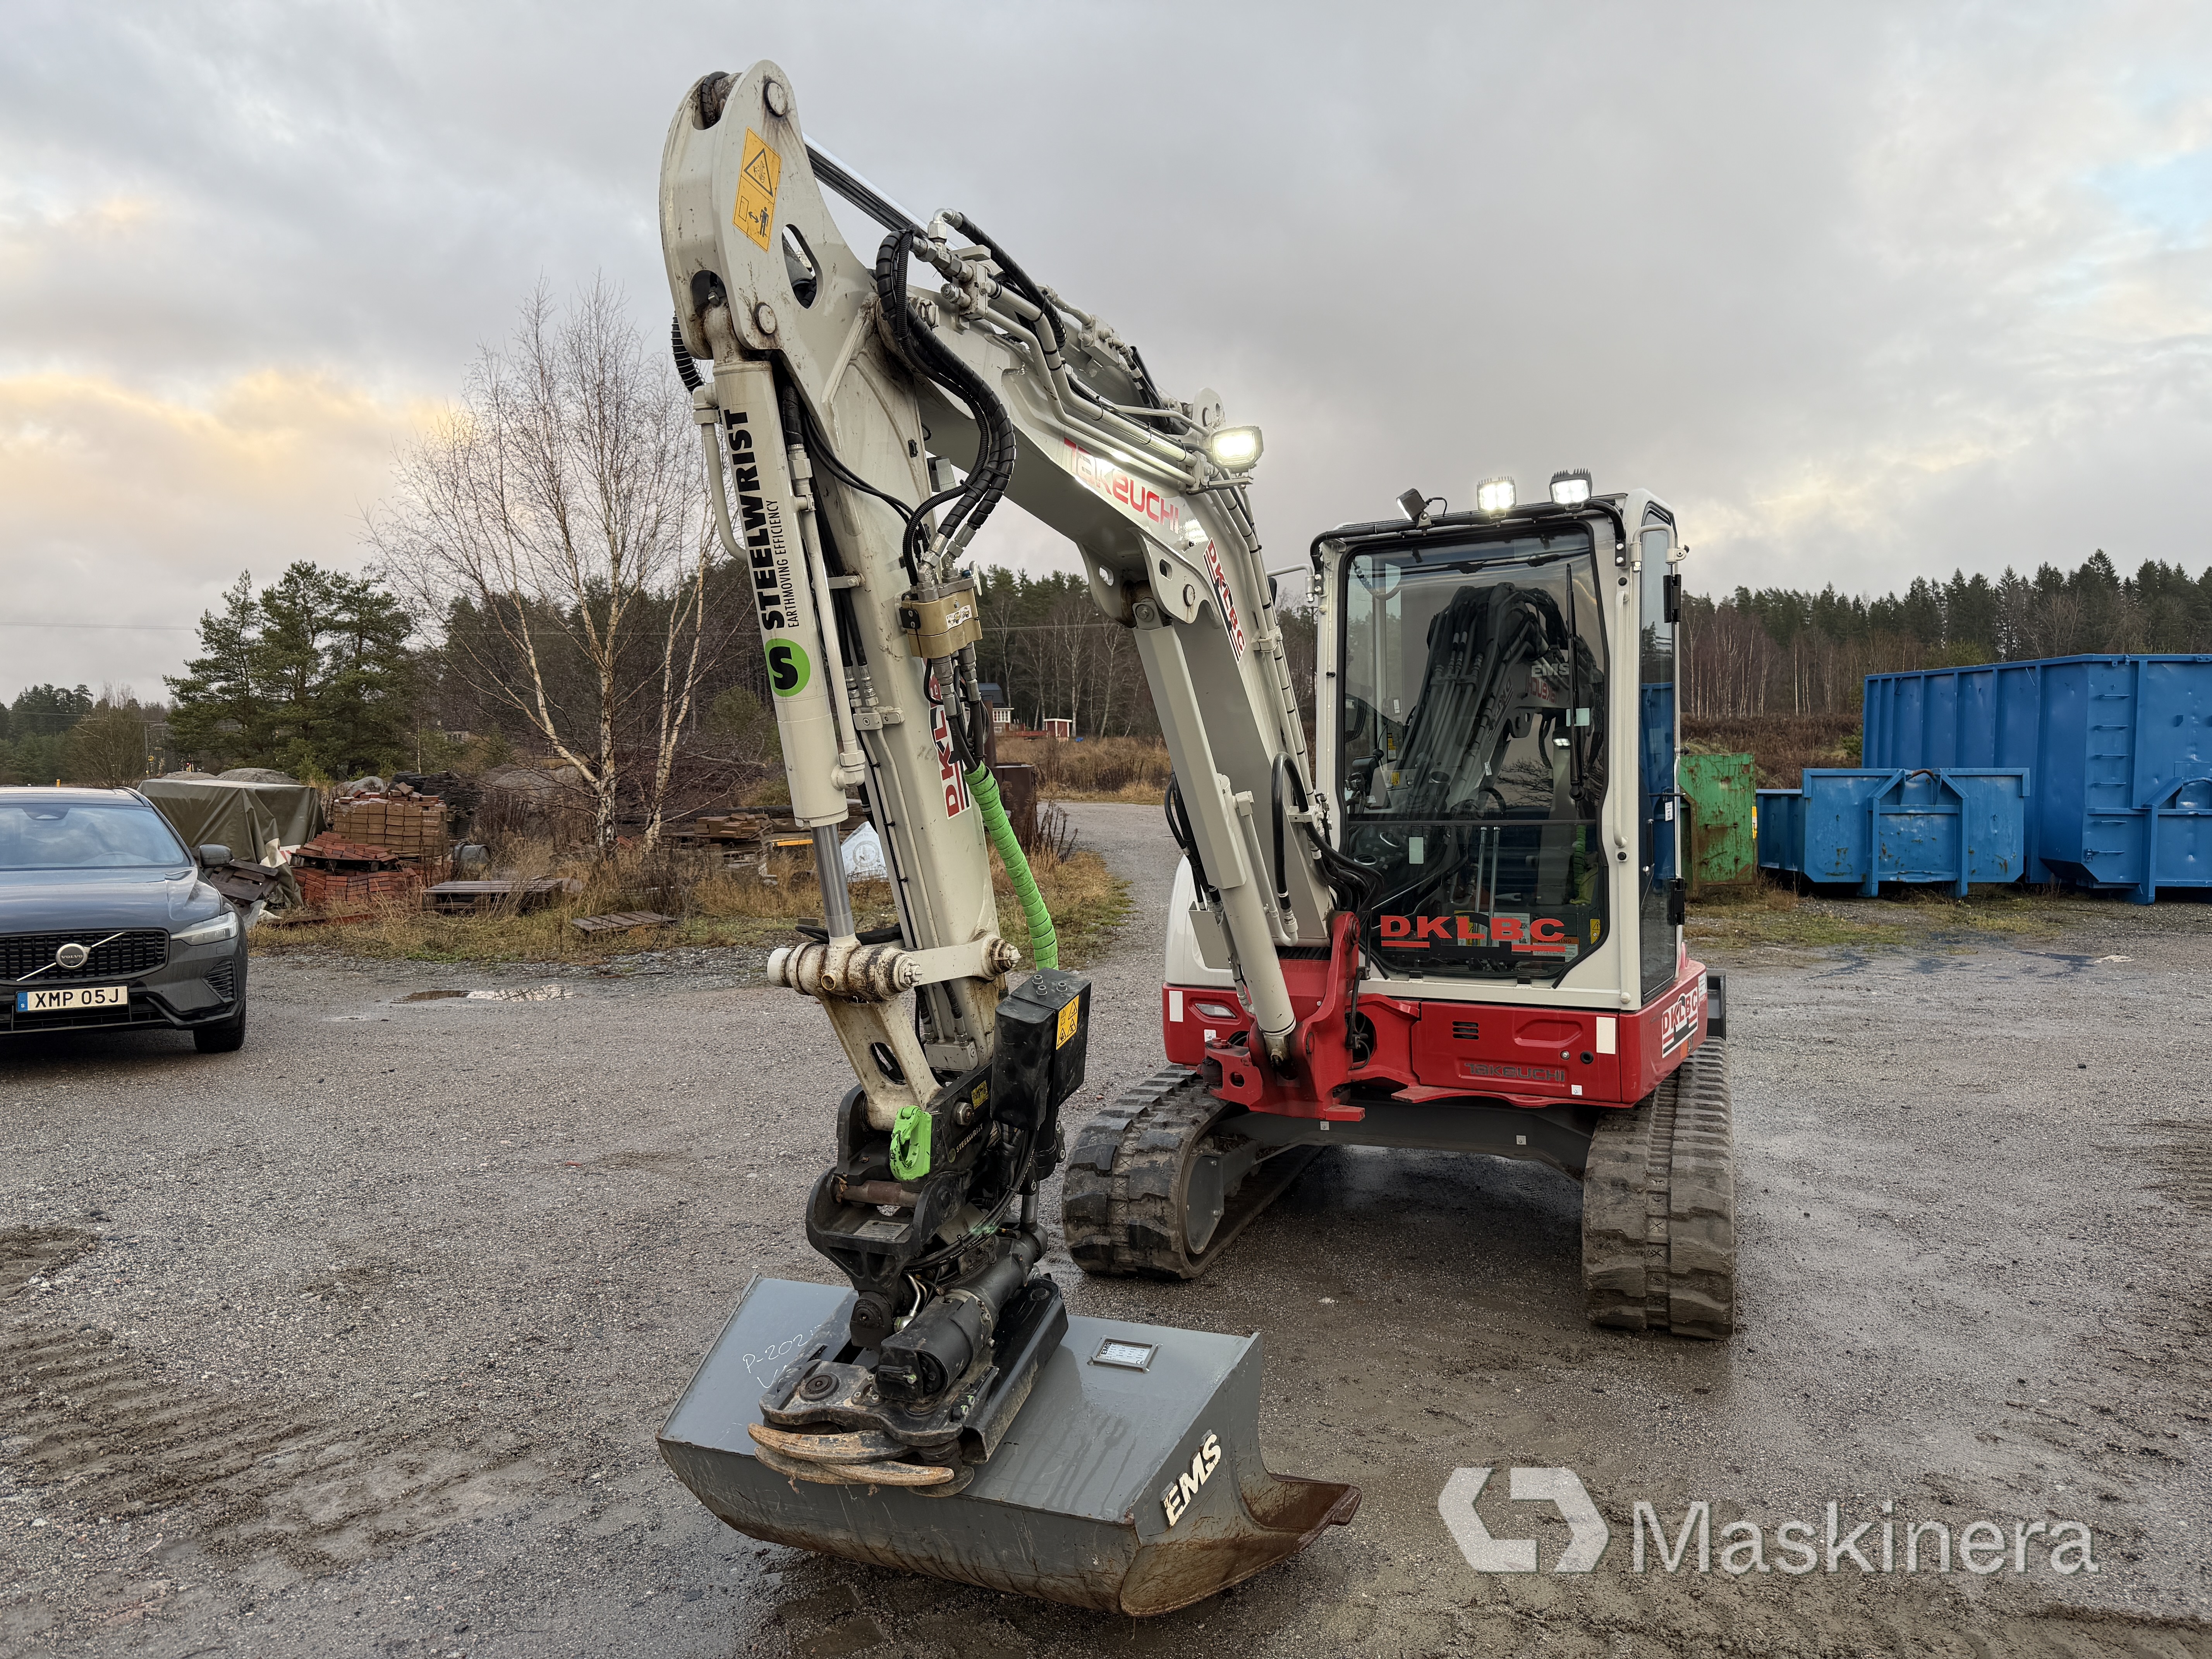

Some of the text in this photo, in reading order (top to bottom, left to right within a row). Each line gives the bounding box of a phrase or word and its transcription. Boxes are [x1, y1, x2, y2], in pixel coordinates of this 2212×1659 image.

[724, 409, 785, 630] STEELWRIST
[766, 500, 799, 629] EARTHMOVING EFFICIENCY
[1207, 539, 1245, 651] DKLBC
[769, 646, 799, 690] S
[1532, 663, 1570, 677] EMS
[923, 658, 960, 817] DKLB
[1381, 915, 1565, 941] DKLBC
[35, 988, 118, 1008] XMP 05J
[1663, 990, 1697, 1035] DKLBC
[956, 1123, 983, 1153] STEELWRIST
[1101, 1342, 1111, 1355] EMS
[1163, 1434, 1221, 1527] EMS
